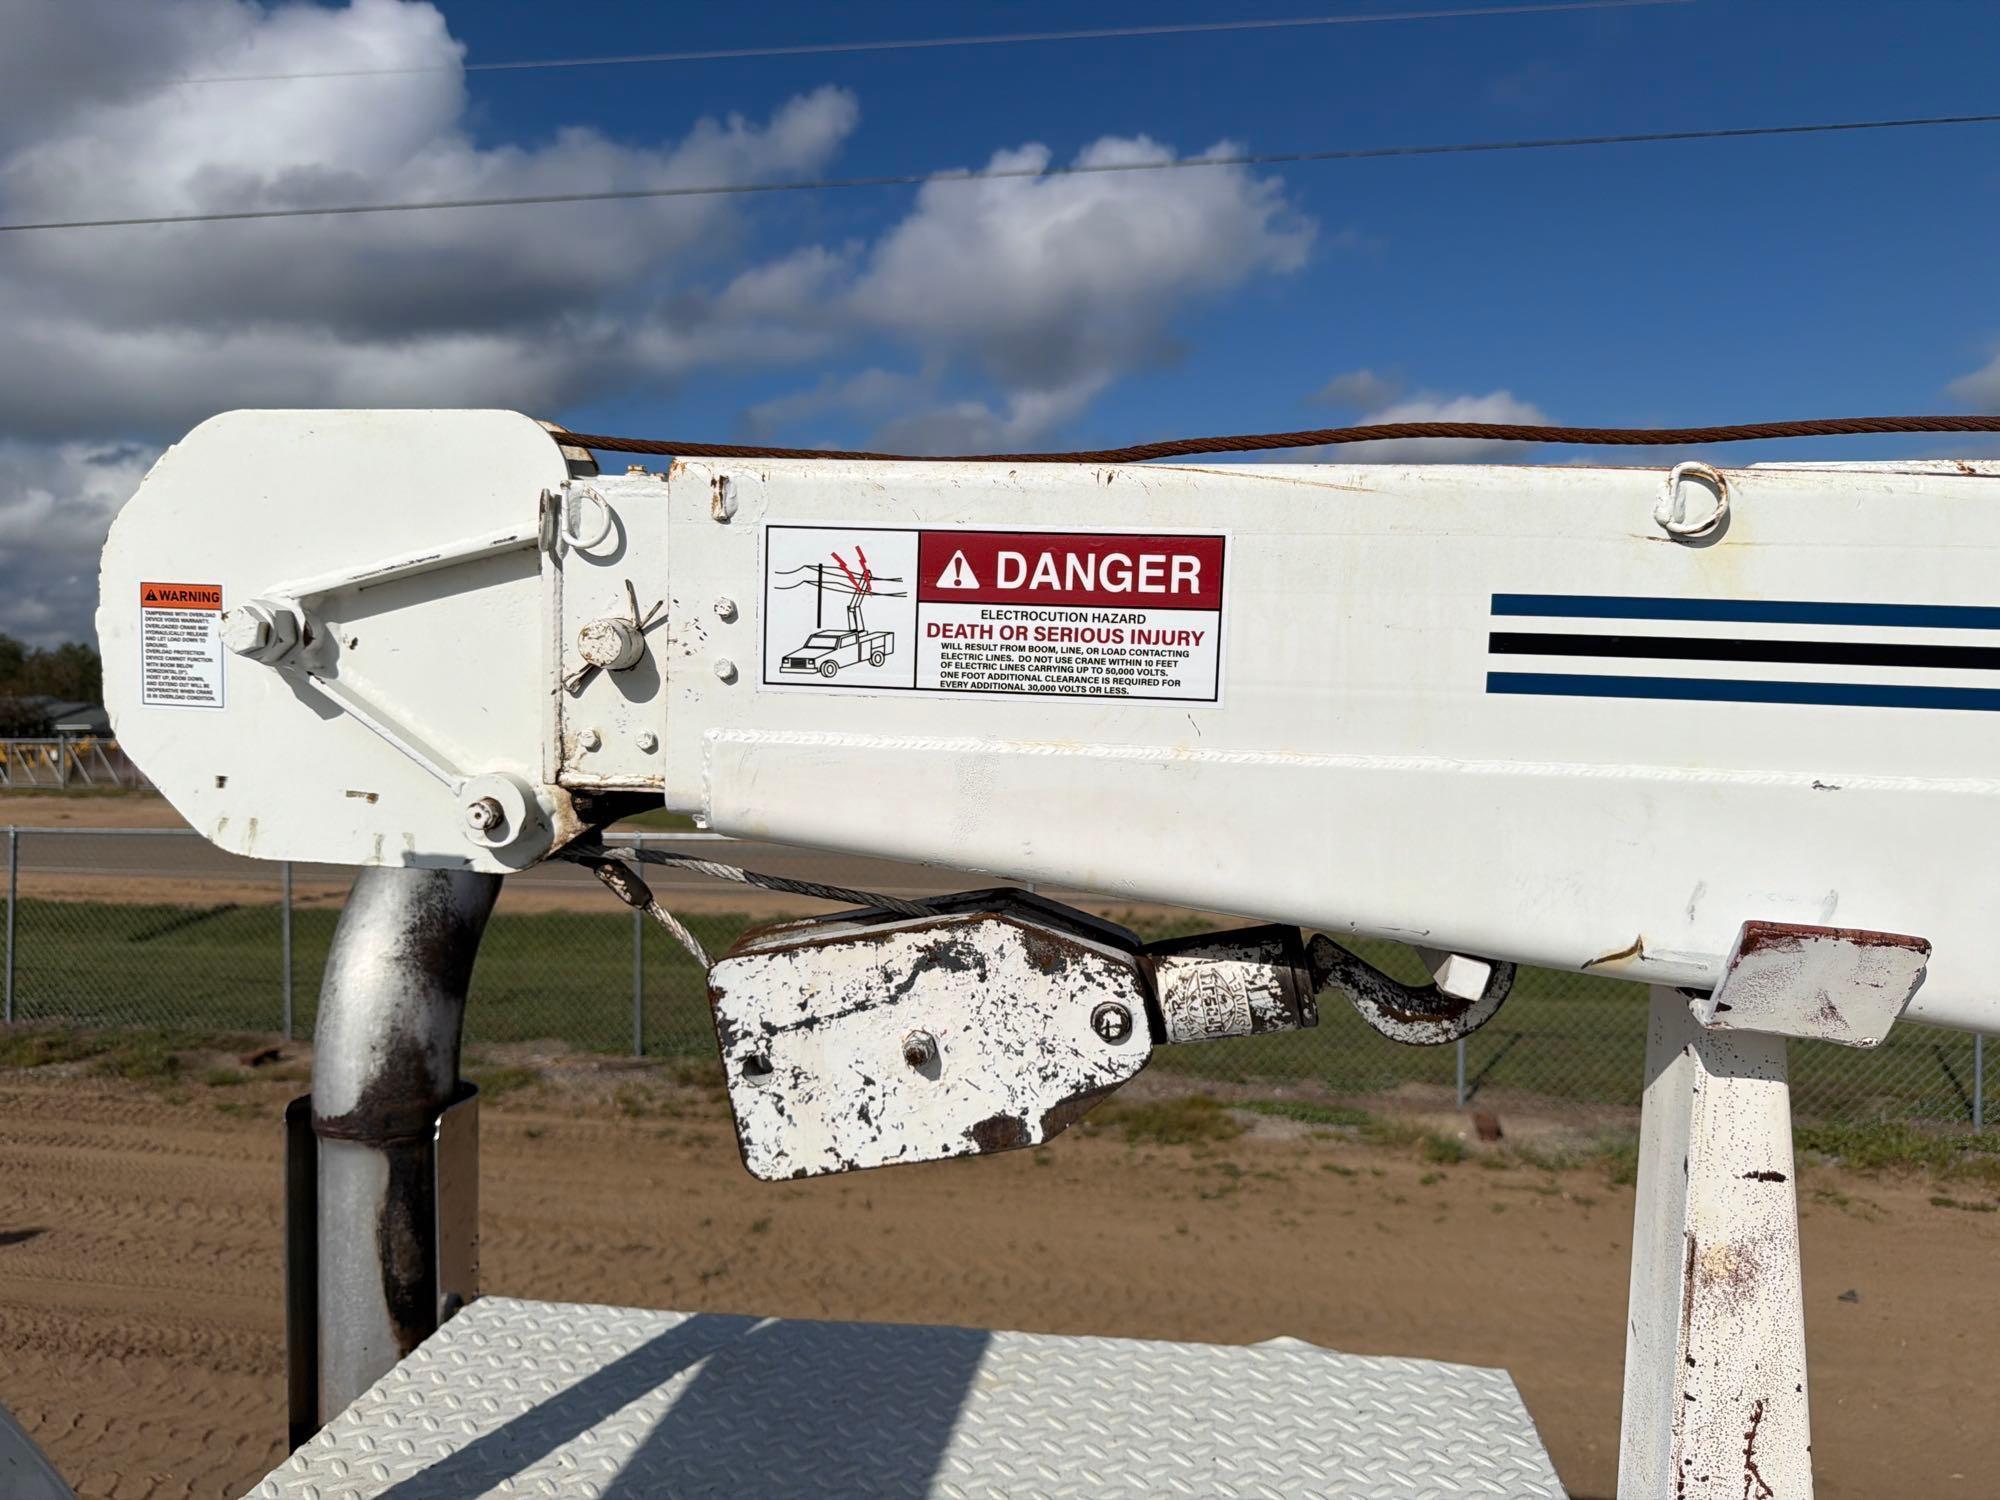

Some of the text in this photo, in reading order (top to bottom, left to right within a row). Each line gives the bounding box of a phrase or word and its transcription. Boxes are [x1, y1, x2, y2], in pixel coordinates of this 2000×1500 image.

[997, 551, 1200, 594] DANGER
[159, 590, 220, 603] WARNING
[981, 610, 1146, 624] ELECTROCUTION HAZARD
[927, 623, 1205, 646] DEATH OR SERIOUS INJURY
[1028, 646, 1058, 654] BOOM,
[1061, 647, 1084, 655] LINE,
[1086, 647, 1099, 655] OR
[1129, 649, 1190, 657] CONTACTING
[941, 653, 983, 661] ELECTRIC
[986, 654, 1014, 662] LINES.
[1075, 657, 1106, 665] CRANE
[1156, 660, 1178, 668] FEET
[955, 662, 997, 670] ELECTRIC
[1028, 664, 1074, 673] CARRYING
[1106, 668, 1134, 676] 50,000
[987, 673, 1041, 682] ADDITIONAL
[1045, 675, 1099, 684] CLEARANCE
[1113, 678, 1159, 686] REQUIRED
[971, 682, 1025, 691] ADDITIONAL
[1104, 687, 1129, 695] LESS.
[1228, 972, 1246, 1027] SWIVEL
